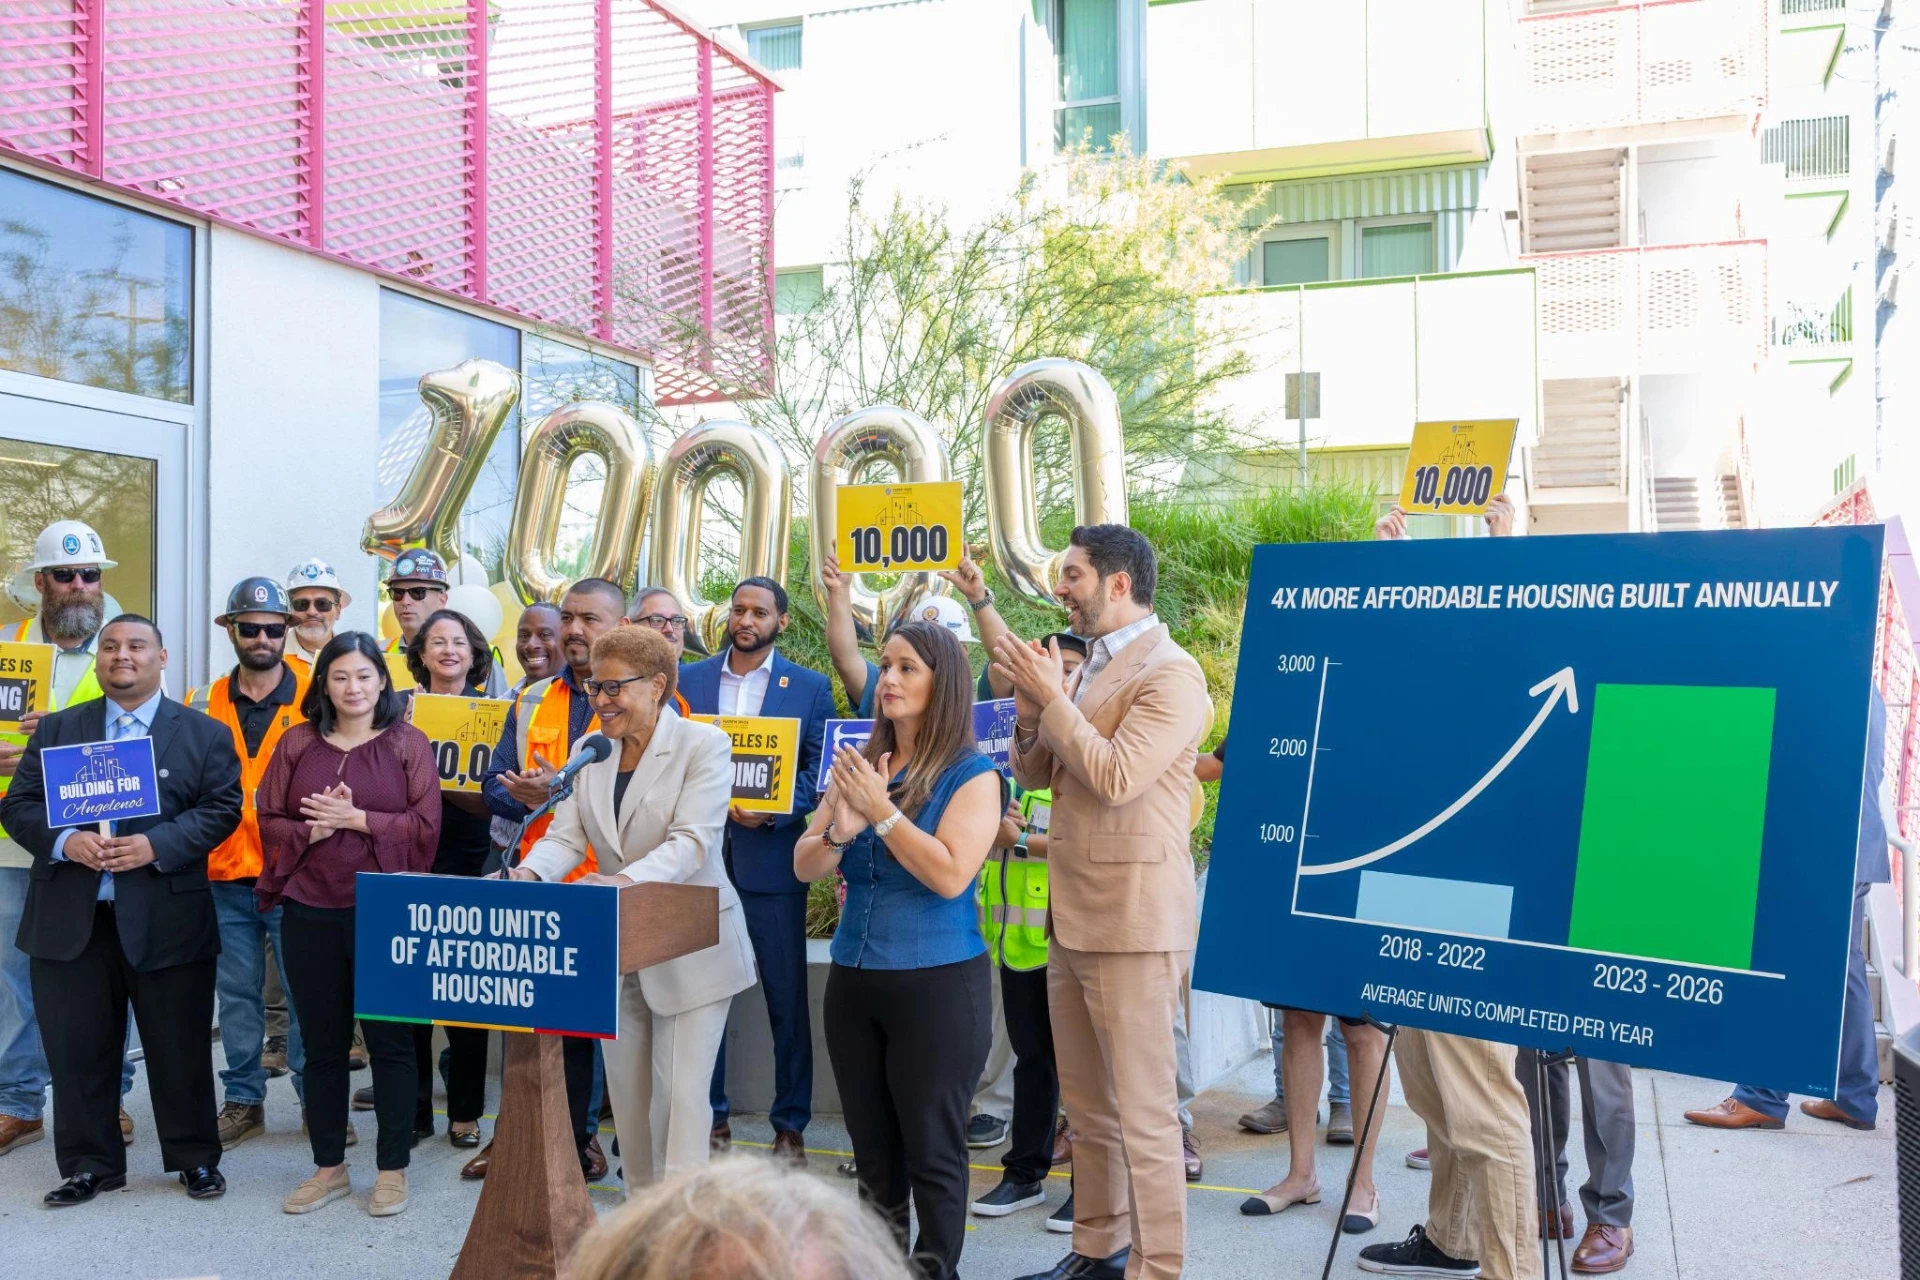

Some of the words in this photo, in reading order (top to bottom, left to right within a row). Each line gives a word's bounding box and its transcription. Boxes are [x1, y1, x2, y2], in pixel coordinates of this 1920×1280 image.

[1413, 466, 1493, 509] 10,000
[850, 525, 948, 568] 10,000
[1271, 587, 1298, 609] 4X
[1301, 587, 1360, 609] MORE
[1362, 585, 1502, 609] AFFORDABLE
[1506, 584, 1615, 609] HOUSING
[1620, 582, 1690, 608] BUILT
[1694, 581, 1839, 608] ANNUALLY
[20, 659, 33, 673] IS
[1277, 654, 1315, 674] 3,000
[726, 732, 763, 749] ELES
[766, 734, 778, 749] IS
[1269, 738, 1307, 758] 2,000
[60, 779, 114, 800] BUILDING
[117, 776, 140, 793] FOR
[62, 797, 144, 819] Angelenos
[1260, 823, 1295, 843] 1,000
[407, 903, 483, 936] 10,000
[489, 907, 561, 941] UNITS
[391, 936, 421, 965] OF
[426, 937, 578, 977] AFFORDABLE
[1379, 934, 1422, 961] 2018
[1437, 942, 1486, 971] 2022
[432, 972, 535, 1008] HOUSING
[1593, 963, 1647, 994] 2023
[1666, 973, 1724, 1005] 2026
[1361, 982, 1424, 1010] AVERAGE
[1428, 996, 1472, 1017] UNITS
[1475, 1002, 1569, 1034] COMPLETED
[1573, 1019, 1604, 1039] PER
[1609, 1022, 1654, 1047] YEAR
